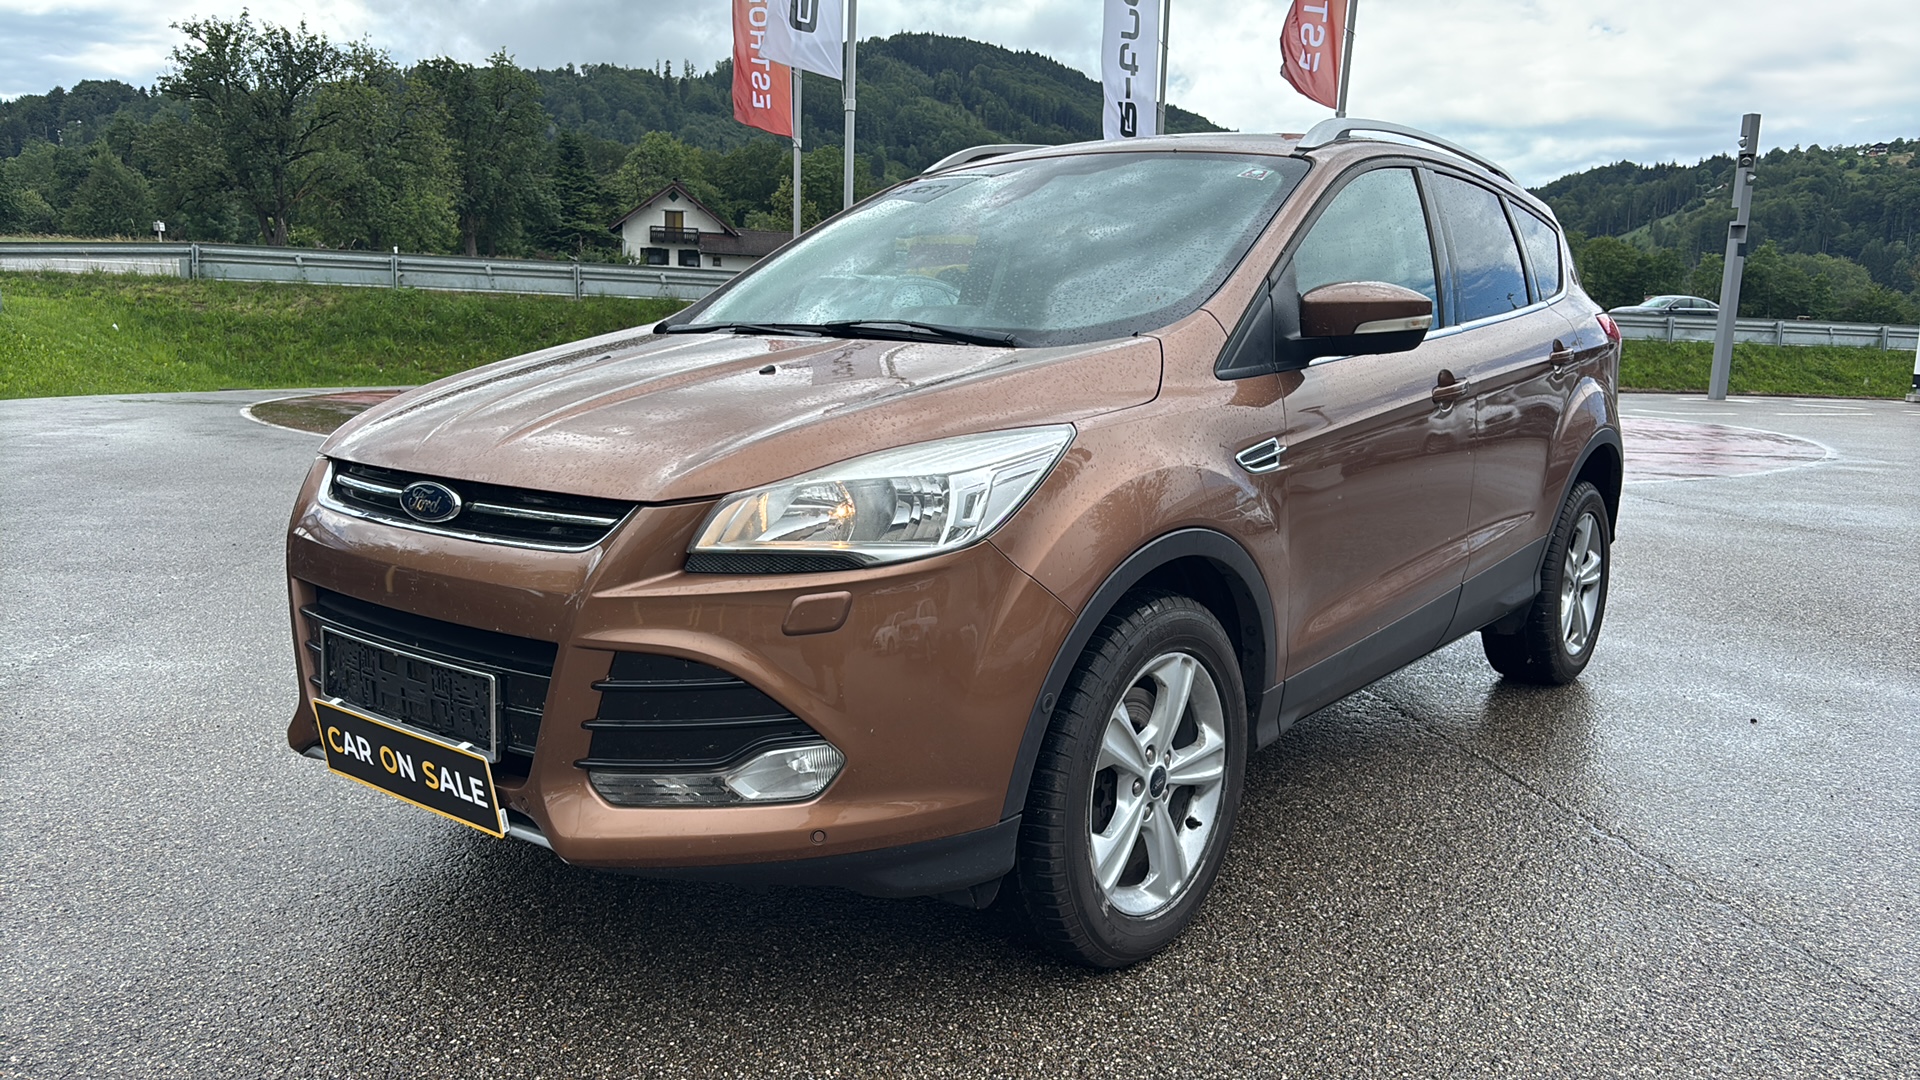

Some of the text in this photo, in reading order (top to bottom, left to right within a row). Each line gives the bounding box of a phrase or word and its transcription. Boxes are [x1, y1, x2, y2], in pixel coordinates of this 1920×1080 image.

[408, 486, 442, 513] Ford
[327, 726, 489, 808] CAR ON SALE
